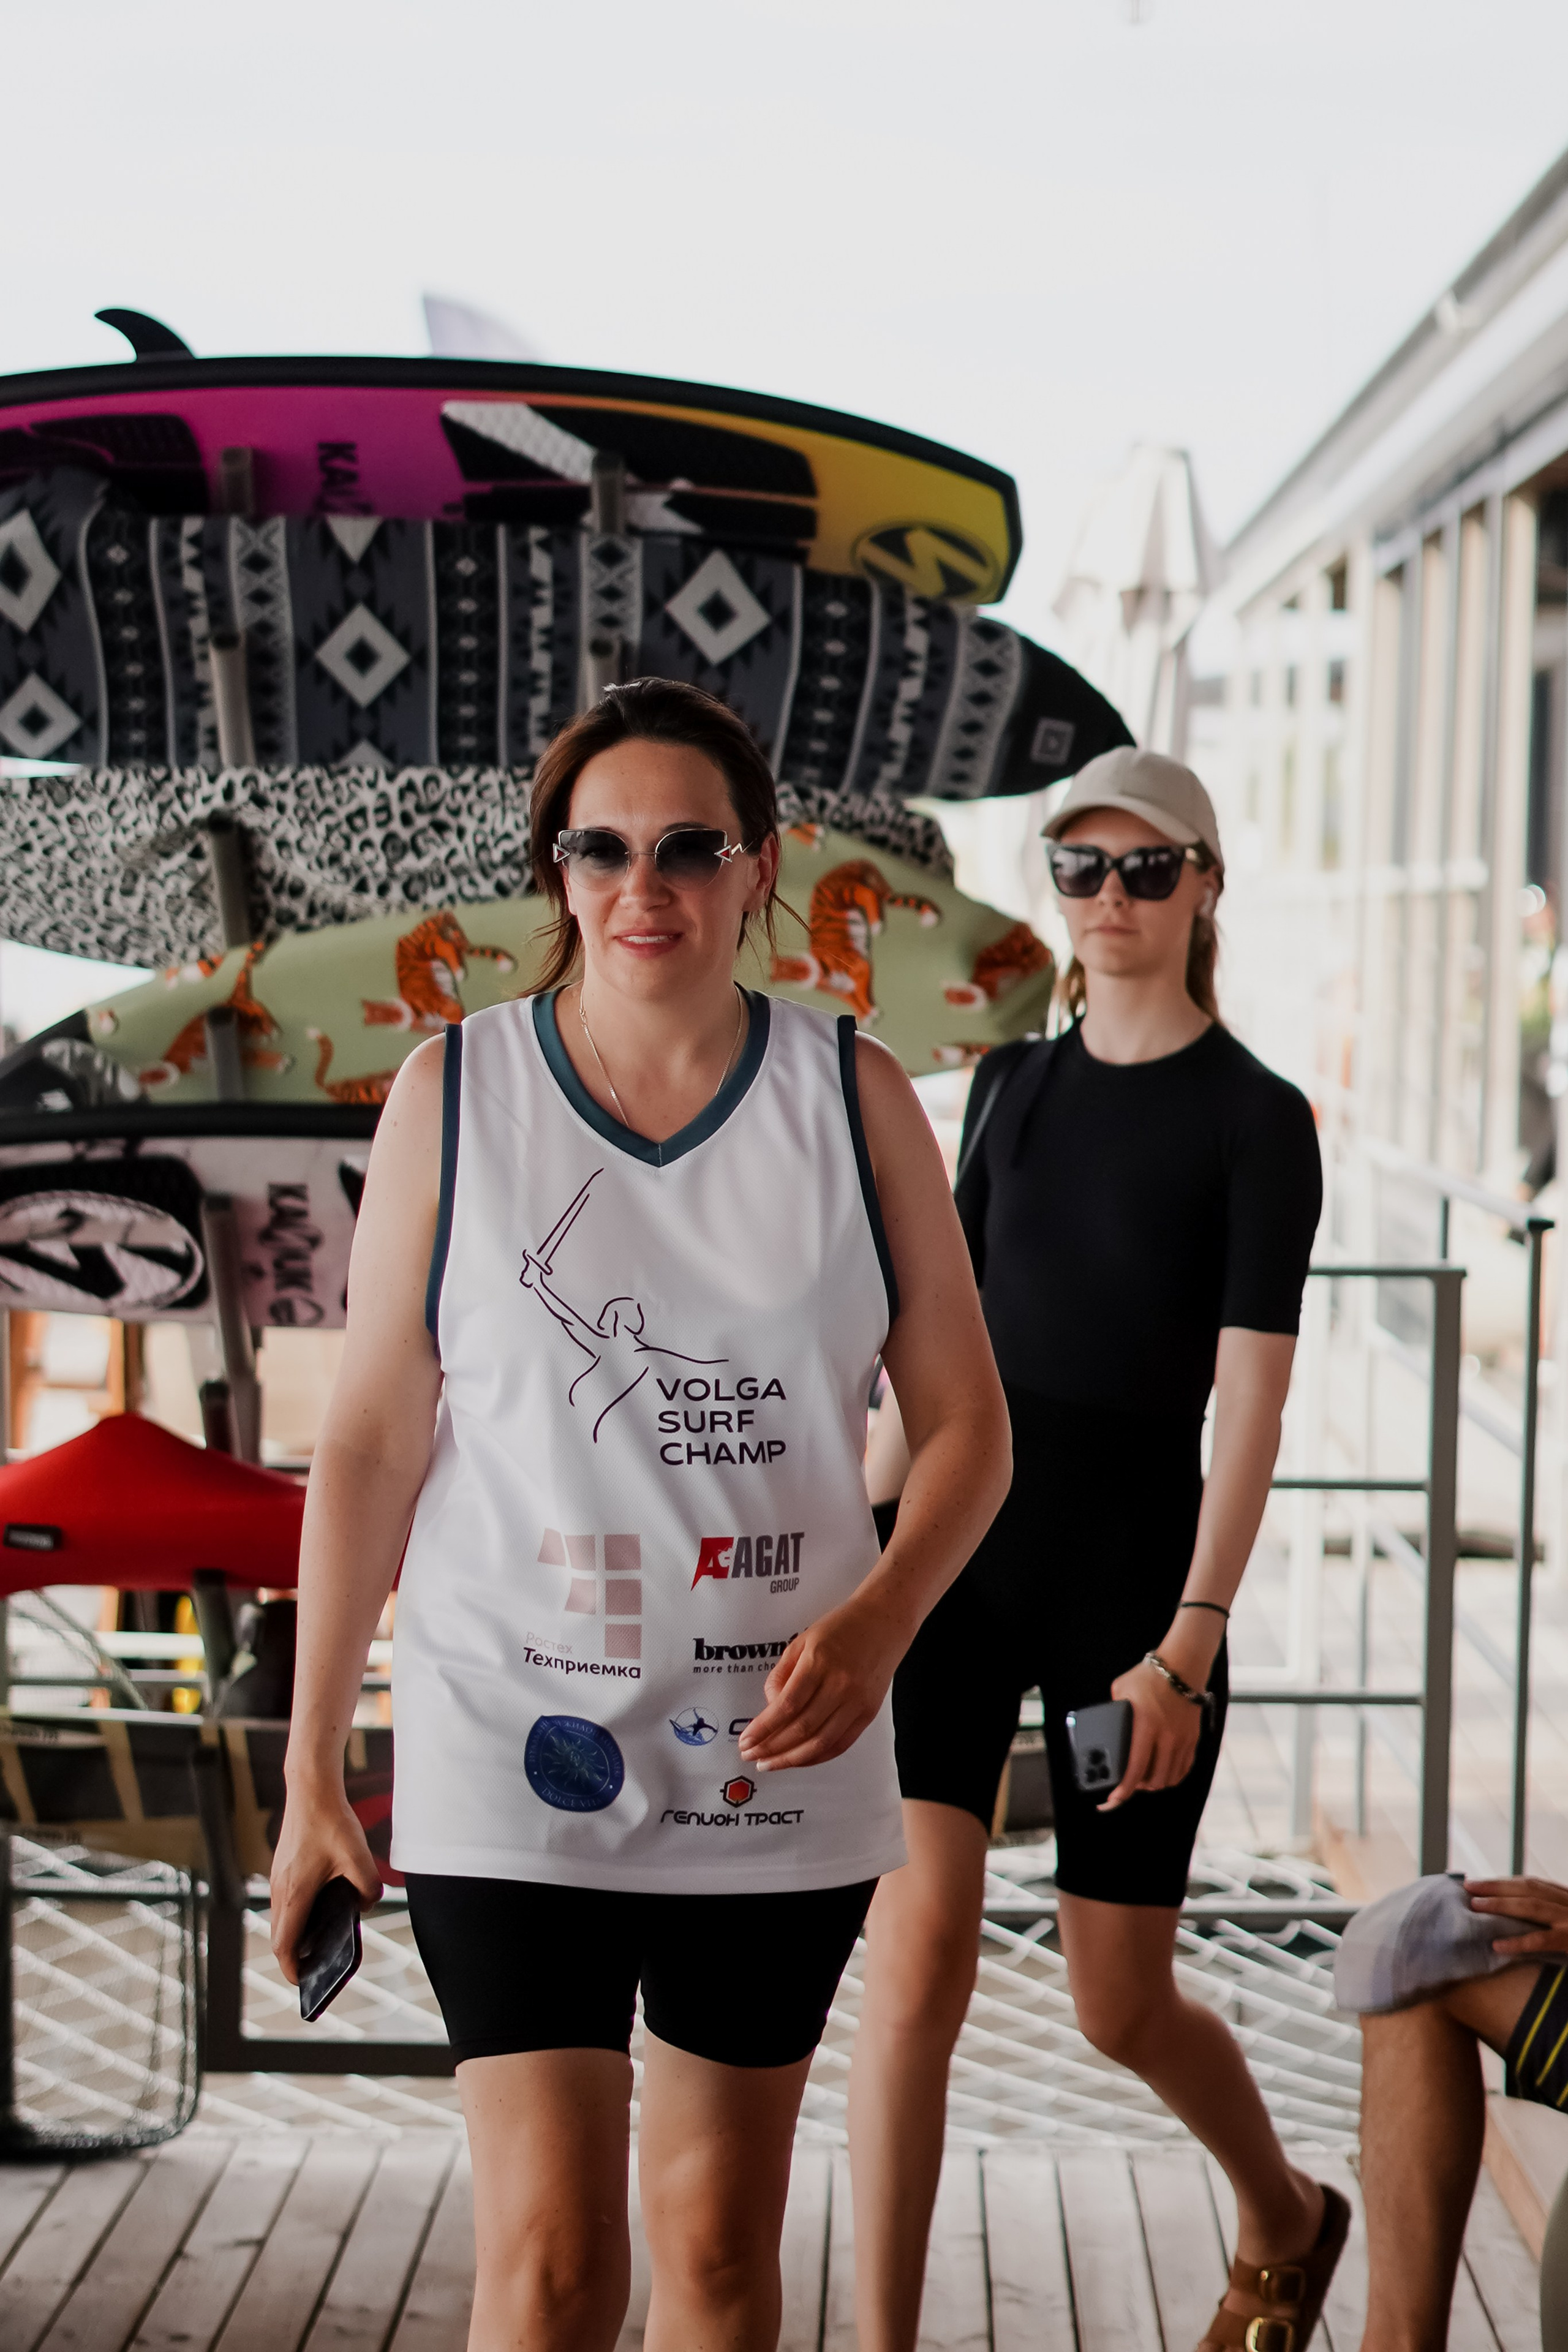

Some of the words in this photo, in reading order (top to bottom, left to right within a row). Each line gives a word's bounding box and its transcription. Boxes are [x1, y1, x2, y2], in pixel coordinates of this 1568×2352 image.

[656, 1377, 786, 1401] VOLGA
[658, 1409, 755, 1433] SURF
[660, 1440, 786, 1466] CHAMP
[731, 1532, 805, 1578] AGAT
[770, 1577, 800, 1594] GROUP
[526, 1631, 573, 1654] Ростех
[693, 1632, 799, 1660] brown
[523, 1646, 641, 1679] Техприемка
[693, 1665, 723, 1673] more
[727, 1664, 753, 1673] than
